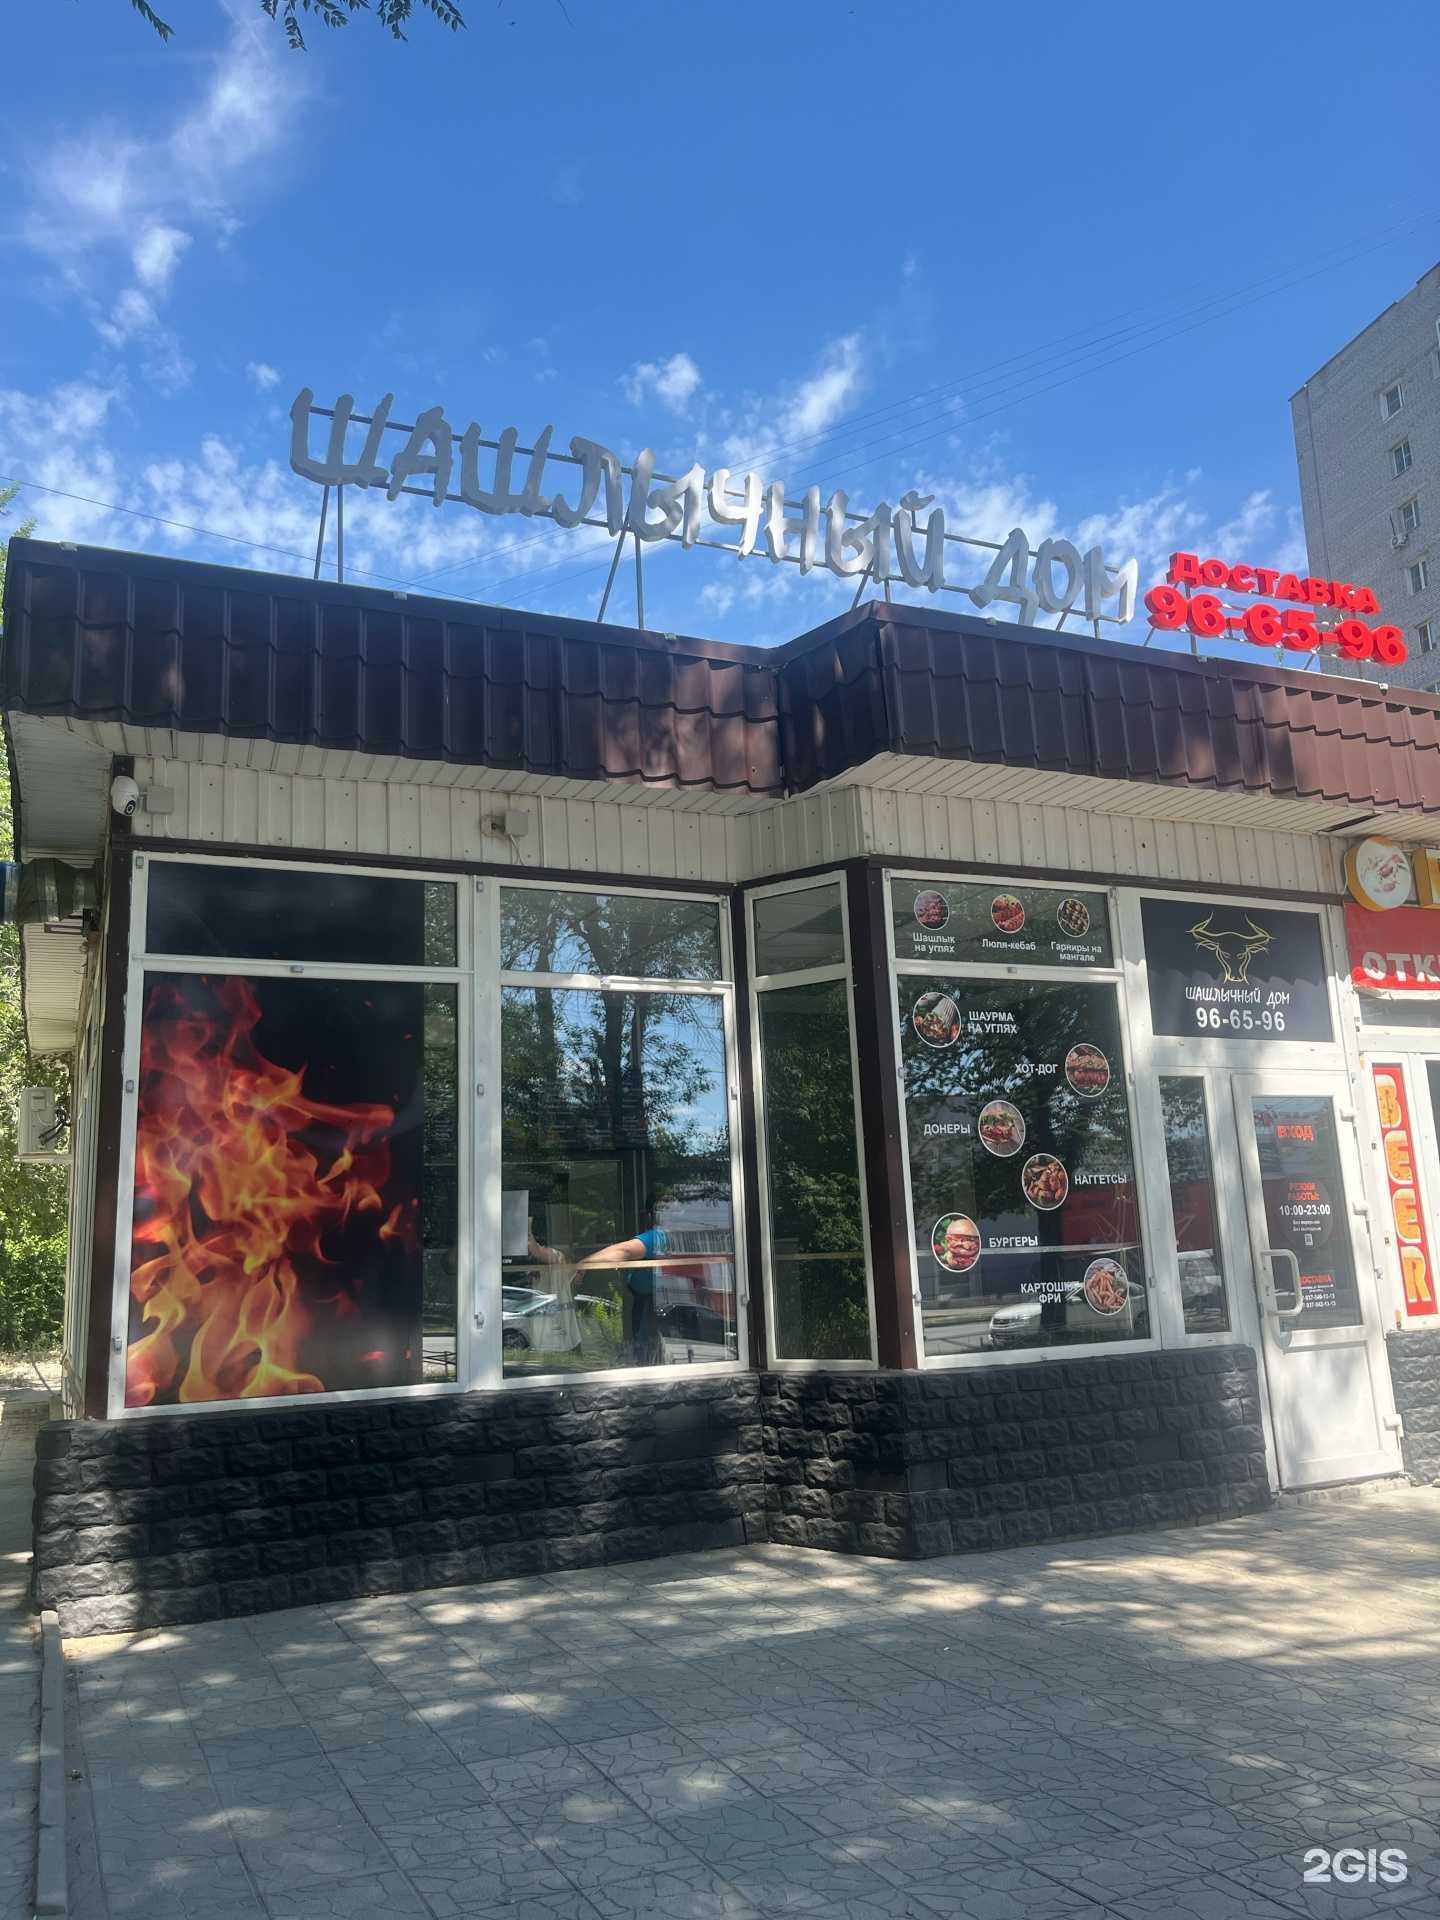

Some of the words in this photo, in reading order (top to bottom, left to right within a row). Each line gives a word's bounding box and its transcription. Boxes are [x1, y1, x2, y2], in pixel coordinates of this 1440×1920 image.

[289, 387, 946, 594] ШАШЛЫЧНЫЙ
[969, 527, 1139, 626] ДОМ
[1167, 551, 1380, 615] ДОСТАВКА
[1144, 585, 1408, 666] 96-65-96
[912, 932, 956, 944] Шашлык
[982, 938, 1036, 951] Люля-кебаб
[915, 944, 927, 952] на
[928, 944, 955, 954] углях
[1050, 941, 1090, 954] Гарниры
[1091, 945, 1102, 953] на
[1059, 952, 1096, 962] мангале
[1362, 951, 1440, 982] ОТК
[1185, 986, 1261, 1003] ШАШЛЫЧНЫЙ
[1266, 991, 1290, 1008] ДОМ
[968, 1010, 1014, 1022] ШАУРМА
[1196, 1007, 1286, 1031] 96-65-96
[967, 1022, 984, 1034] НА
[985, 1022, 1017, 1034] УГЛЯХ
[1014, 1062, 1058, 1075] ХОТ-ДОГ
[923, 1122, 971, 1136] ДОНЕРЫ
[1074, 1173, 1127, 1185] НАГГЕТСЫ
[1375, 1074, 1432, 1303] BEER
[1280, 1204, 1331, 1216] 10:00-23:00
[988, 1235, 1038, 1249] БУРГЕРЫ
[1038, 1293, 1062, 1304] ФРИ
